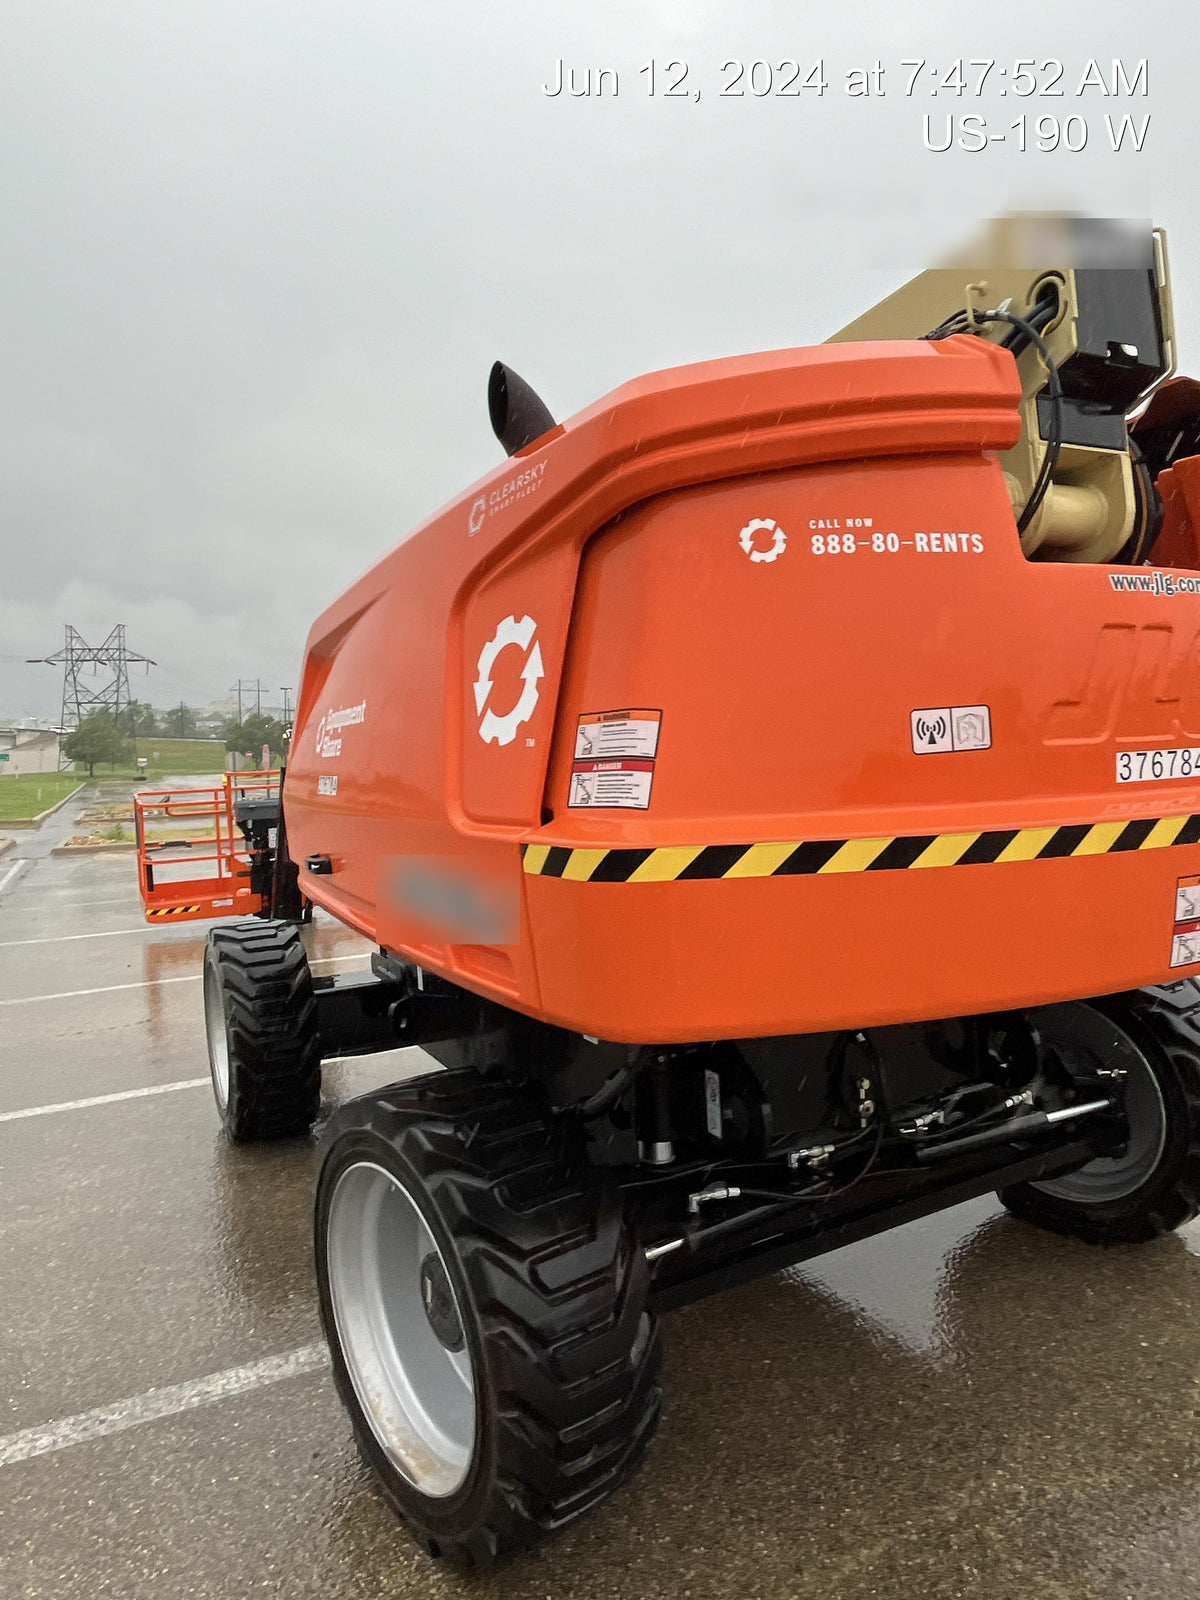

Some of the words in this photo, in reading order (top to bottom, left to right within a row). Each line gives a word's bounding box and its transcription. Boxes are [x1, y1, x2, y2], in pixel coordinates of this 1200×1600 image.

[489, 459, 549, 506] CLEARSKY
[809, 519, 841, 530] CALL
[847, 518, 873, 528] NOW
[810, 532, 984, 555] 888-80-RENTS
